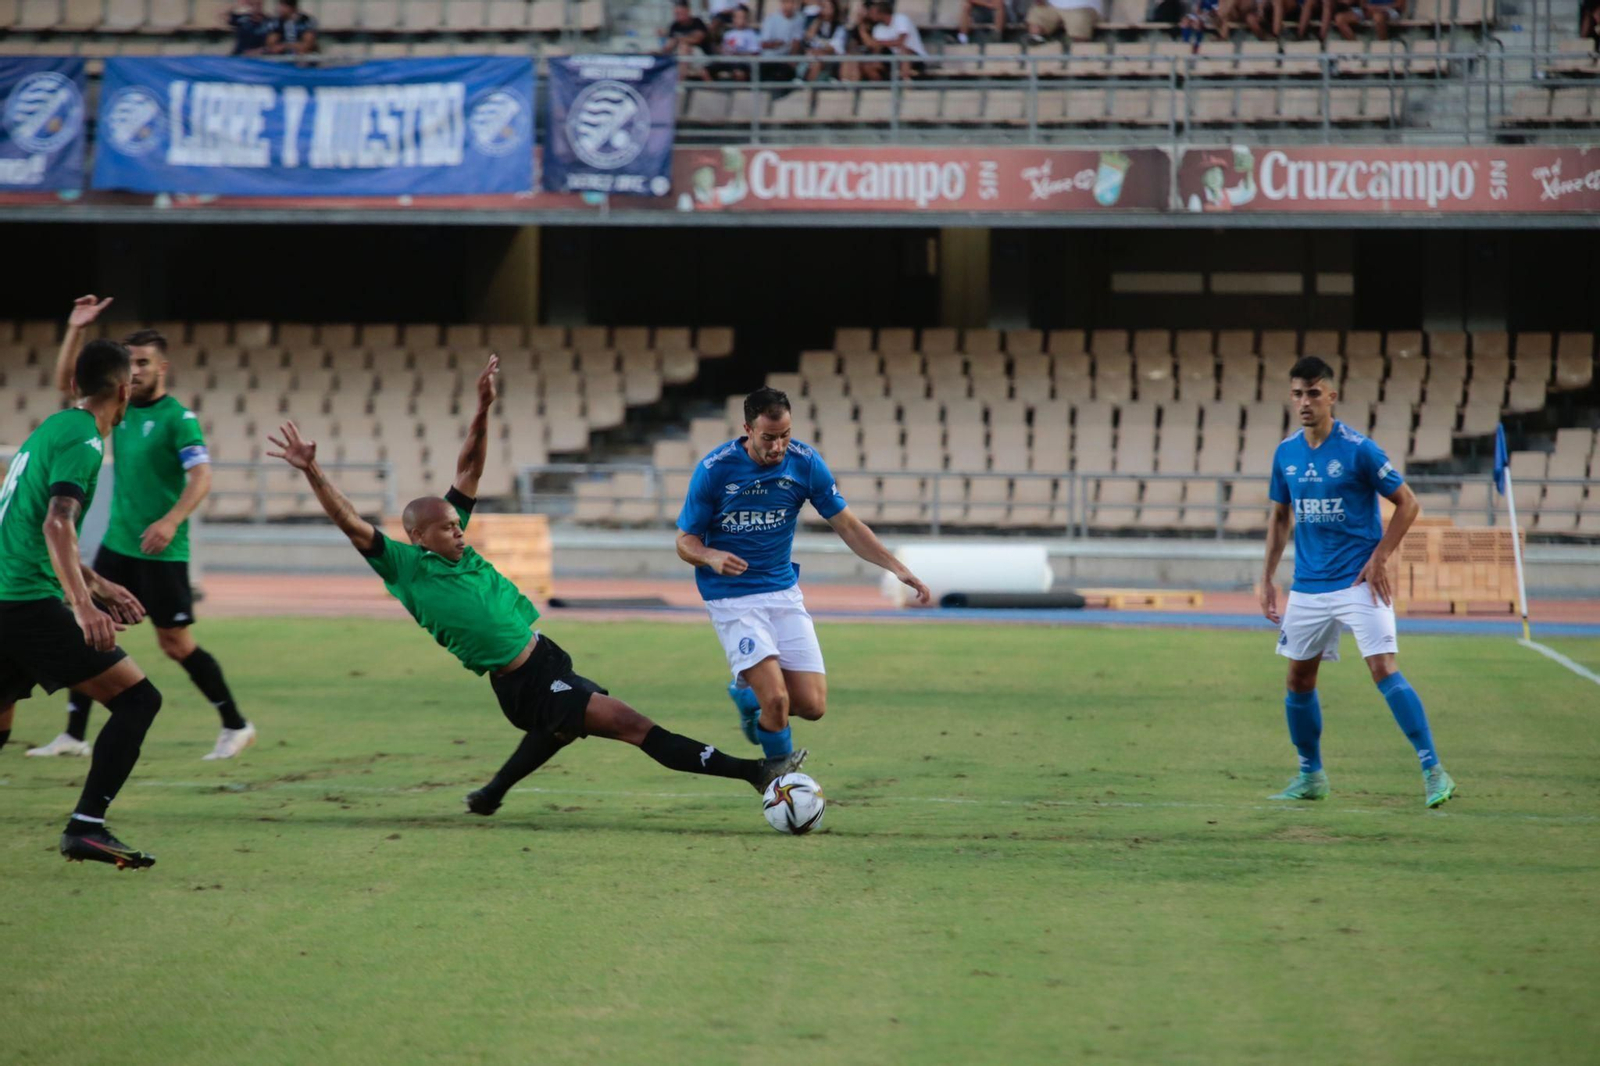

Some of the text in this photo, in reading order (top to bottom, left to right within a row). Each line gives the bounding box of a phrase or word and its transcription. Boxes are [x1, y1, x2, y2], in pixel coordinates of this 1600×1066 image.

[749, 150, 966, 208] Cruzcampo
[979, 160, 999, 200] SIN
[1259, 150, 1476, 208] Cruzcampo
[1489, 159, 1509, 200] SIN
[721, 508, 788, 526] XEREZ
[1295, 497, 1344, 514] XEREZ
[1297, 512, 1346, 524] EPORTIVO
